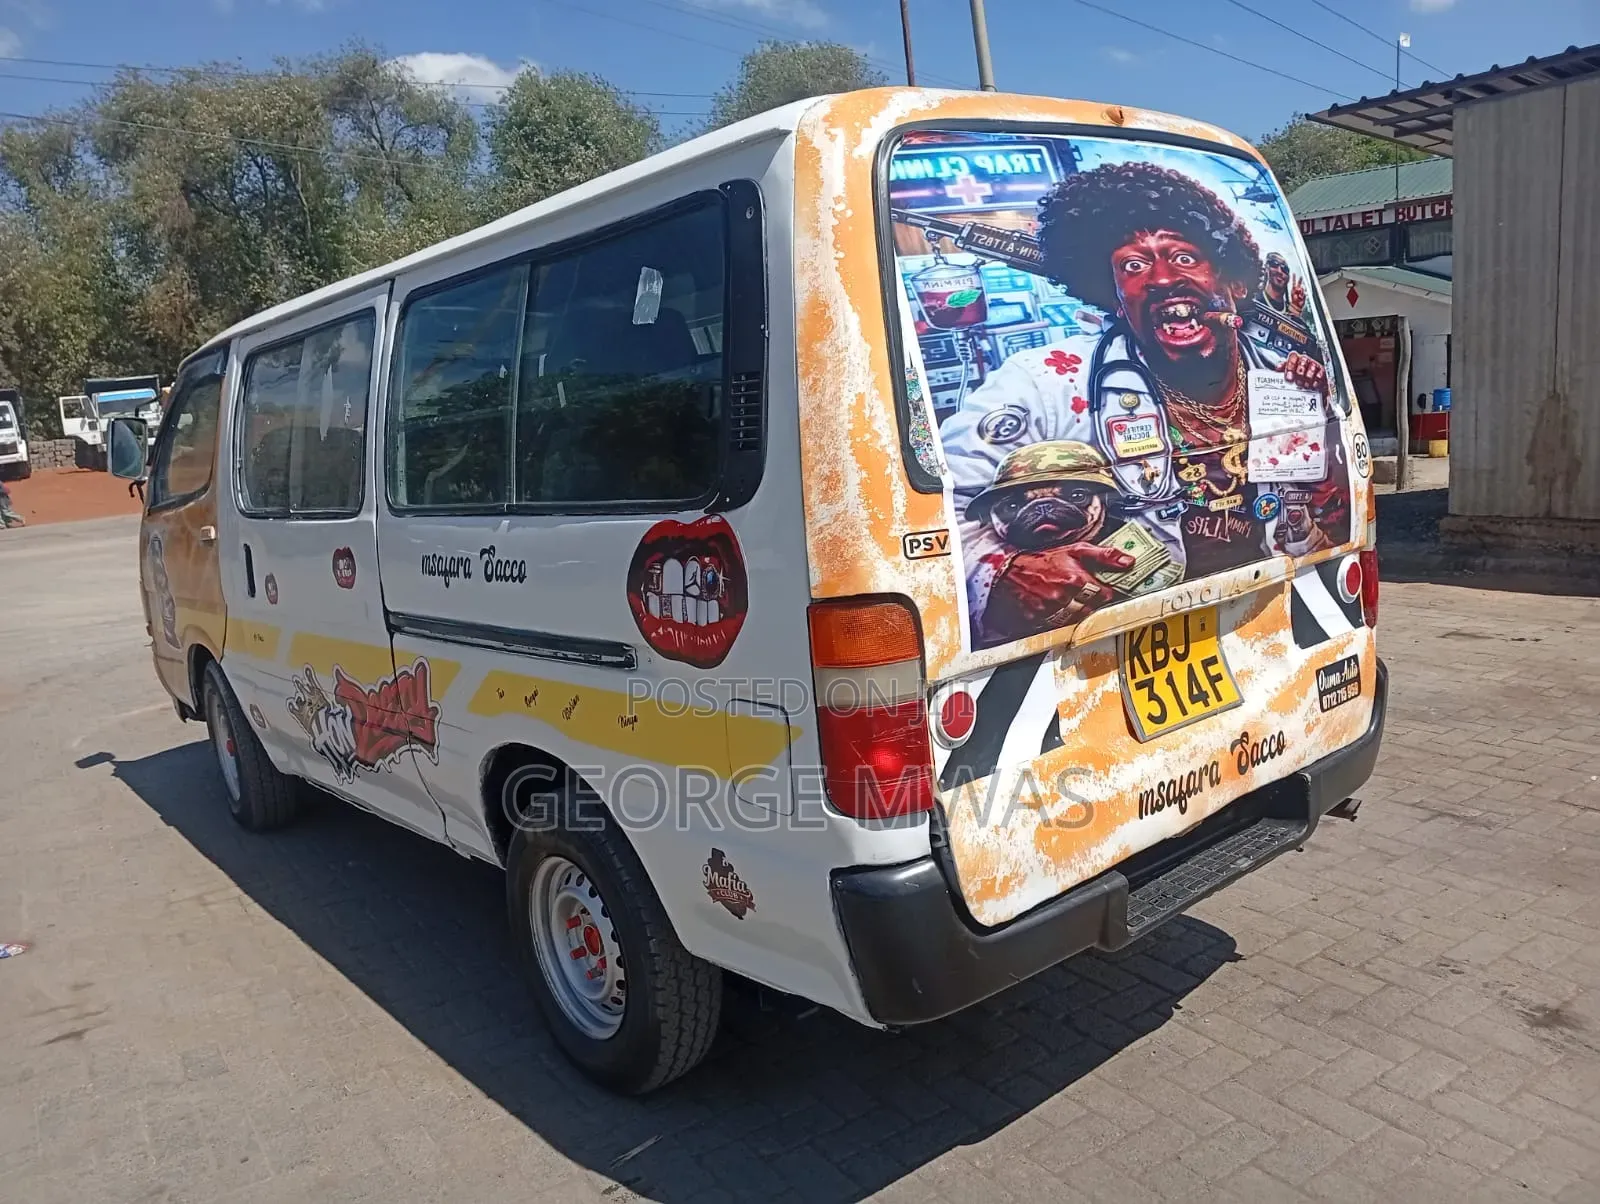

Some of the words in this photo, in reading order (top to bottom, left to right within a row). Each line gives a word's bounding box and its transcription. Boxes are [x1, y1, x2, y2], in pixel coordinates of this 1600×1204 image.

[1355, 441, 1367, 459] 80
[909, 535, 948, 554] PSV
[480, 545, 527, 584] Sacco
[1129, 614, 1191, 680] KBJ
[1134, 655, 1223, 725] 314F
[1230, 731, 1287, 776] Sacco
[702, 864, 748, 896] Mafia
